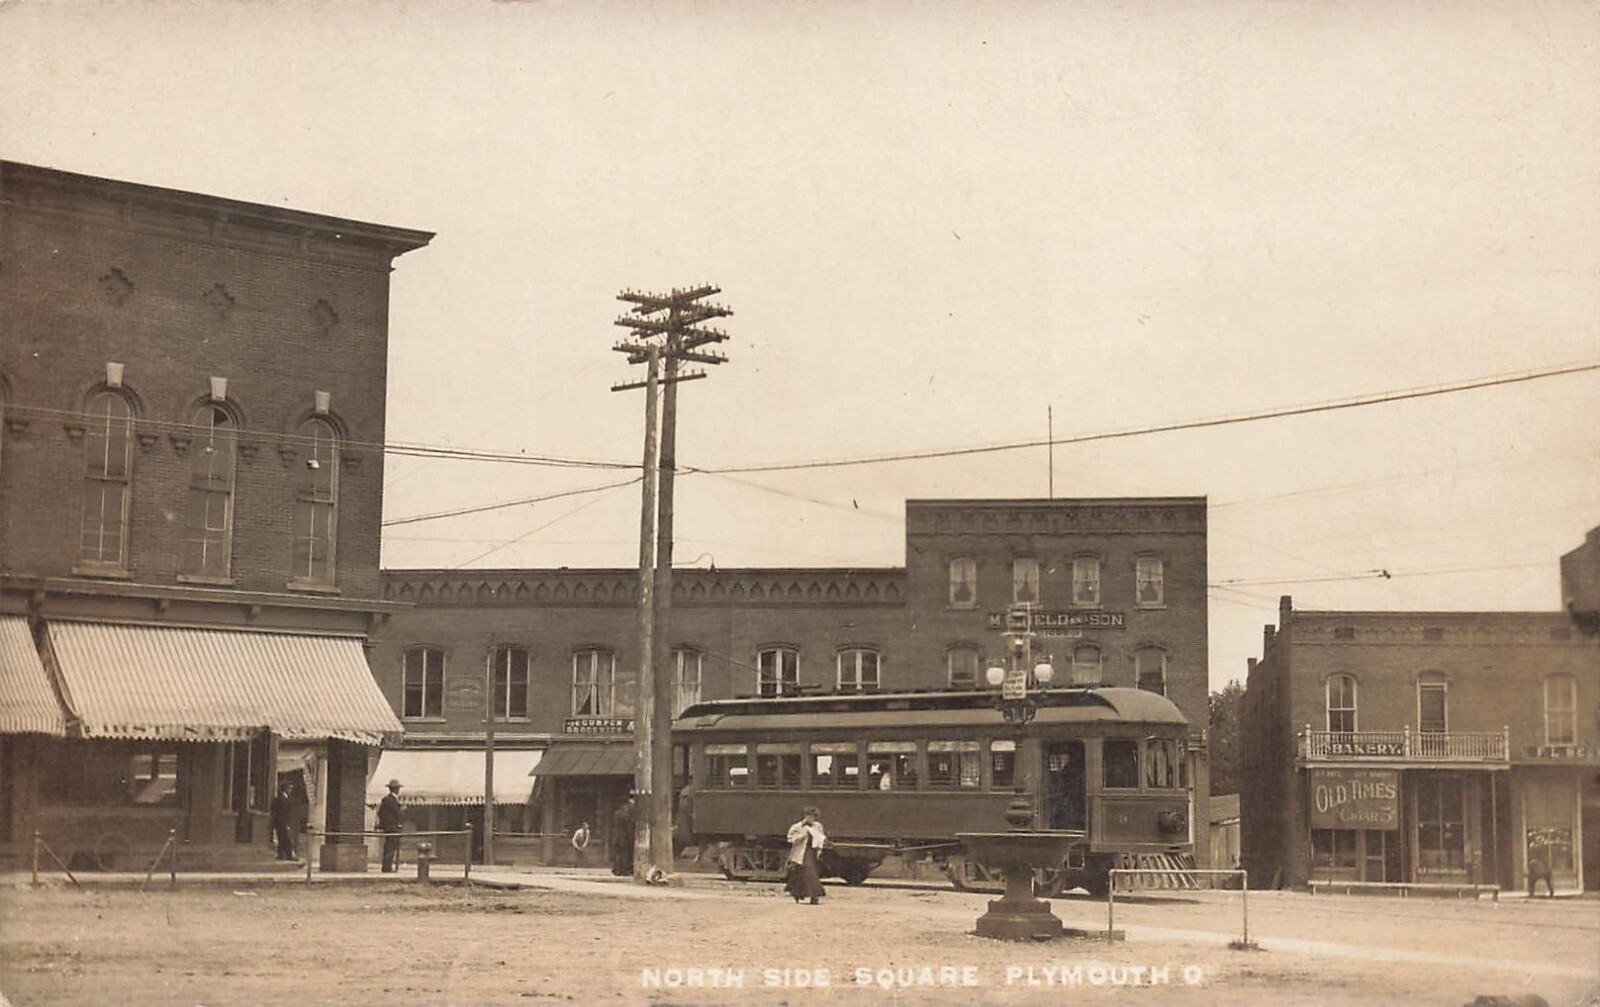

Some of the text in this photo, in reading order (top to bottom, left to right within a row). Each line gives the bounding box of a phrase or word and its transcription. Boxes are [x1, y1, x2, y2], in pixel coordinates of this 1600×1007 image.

[1089, 614, 1124, 626] SON
[1315, 779, 1397, 813] OLD TIMES
